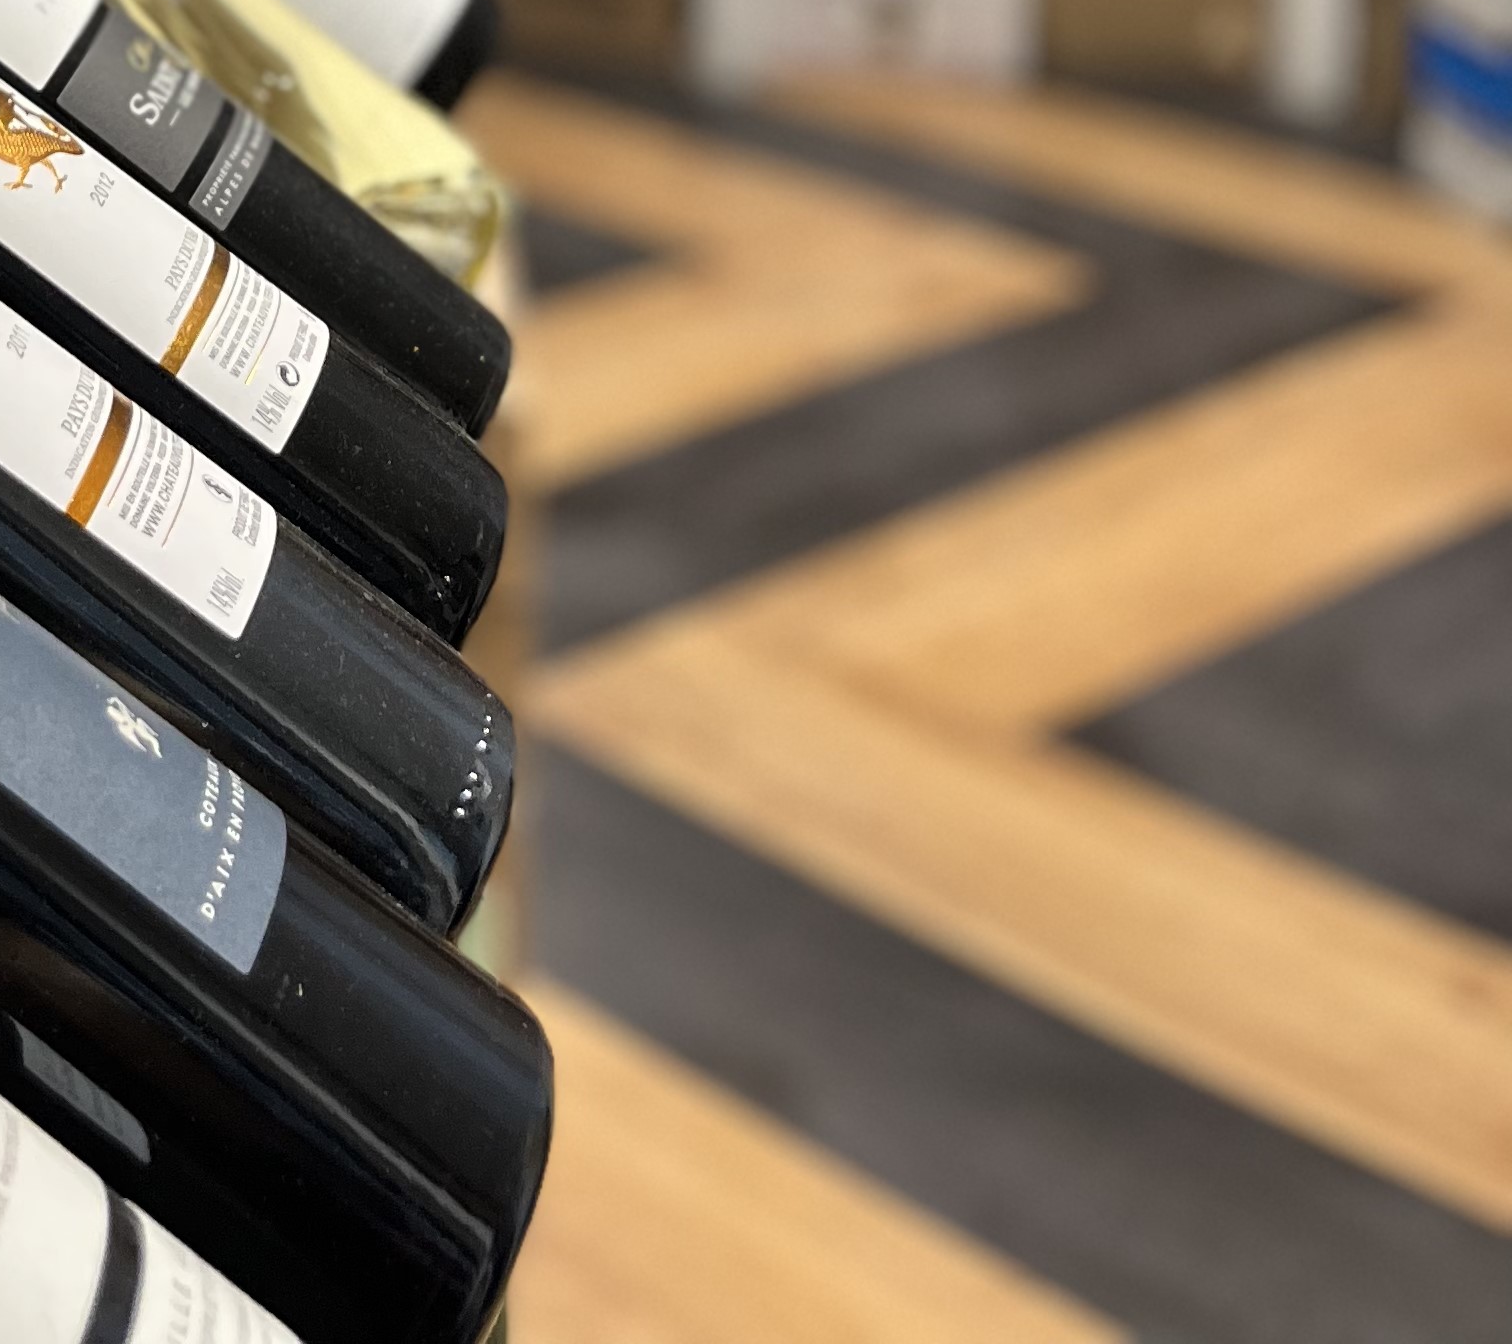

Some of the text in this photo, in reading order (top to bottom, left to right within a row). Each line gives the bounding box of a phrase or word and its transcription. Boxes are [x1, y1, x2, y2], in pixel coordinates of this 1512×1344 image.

[89, 171, 116, 208] 2012
[214, 172, 245, 217] ALPES
[164, 256, 190, 292] PAYS
[6, 323, 30, 360] 2011
[61, 398, 87, 439] PAYS
[200, 847, 236, 923] D'AIX
[226, 812, 243, 844] EN
